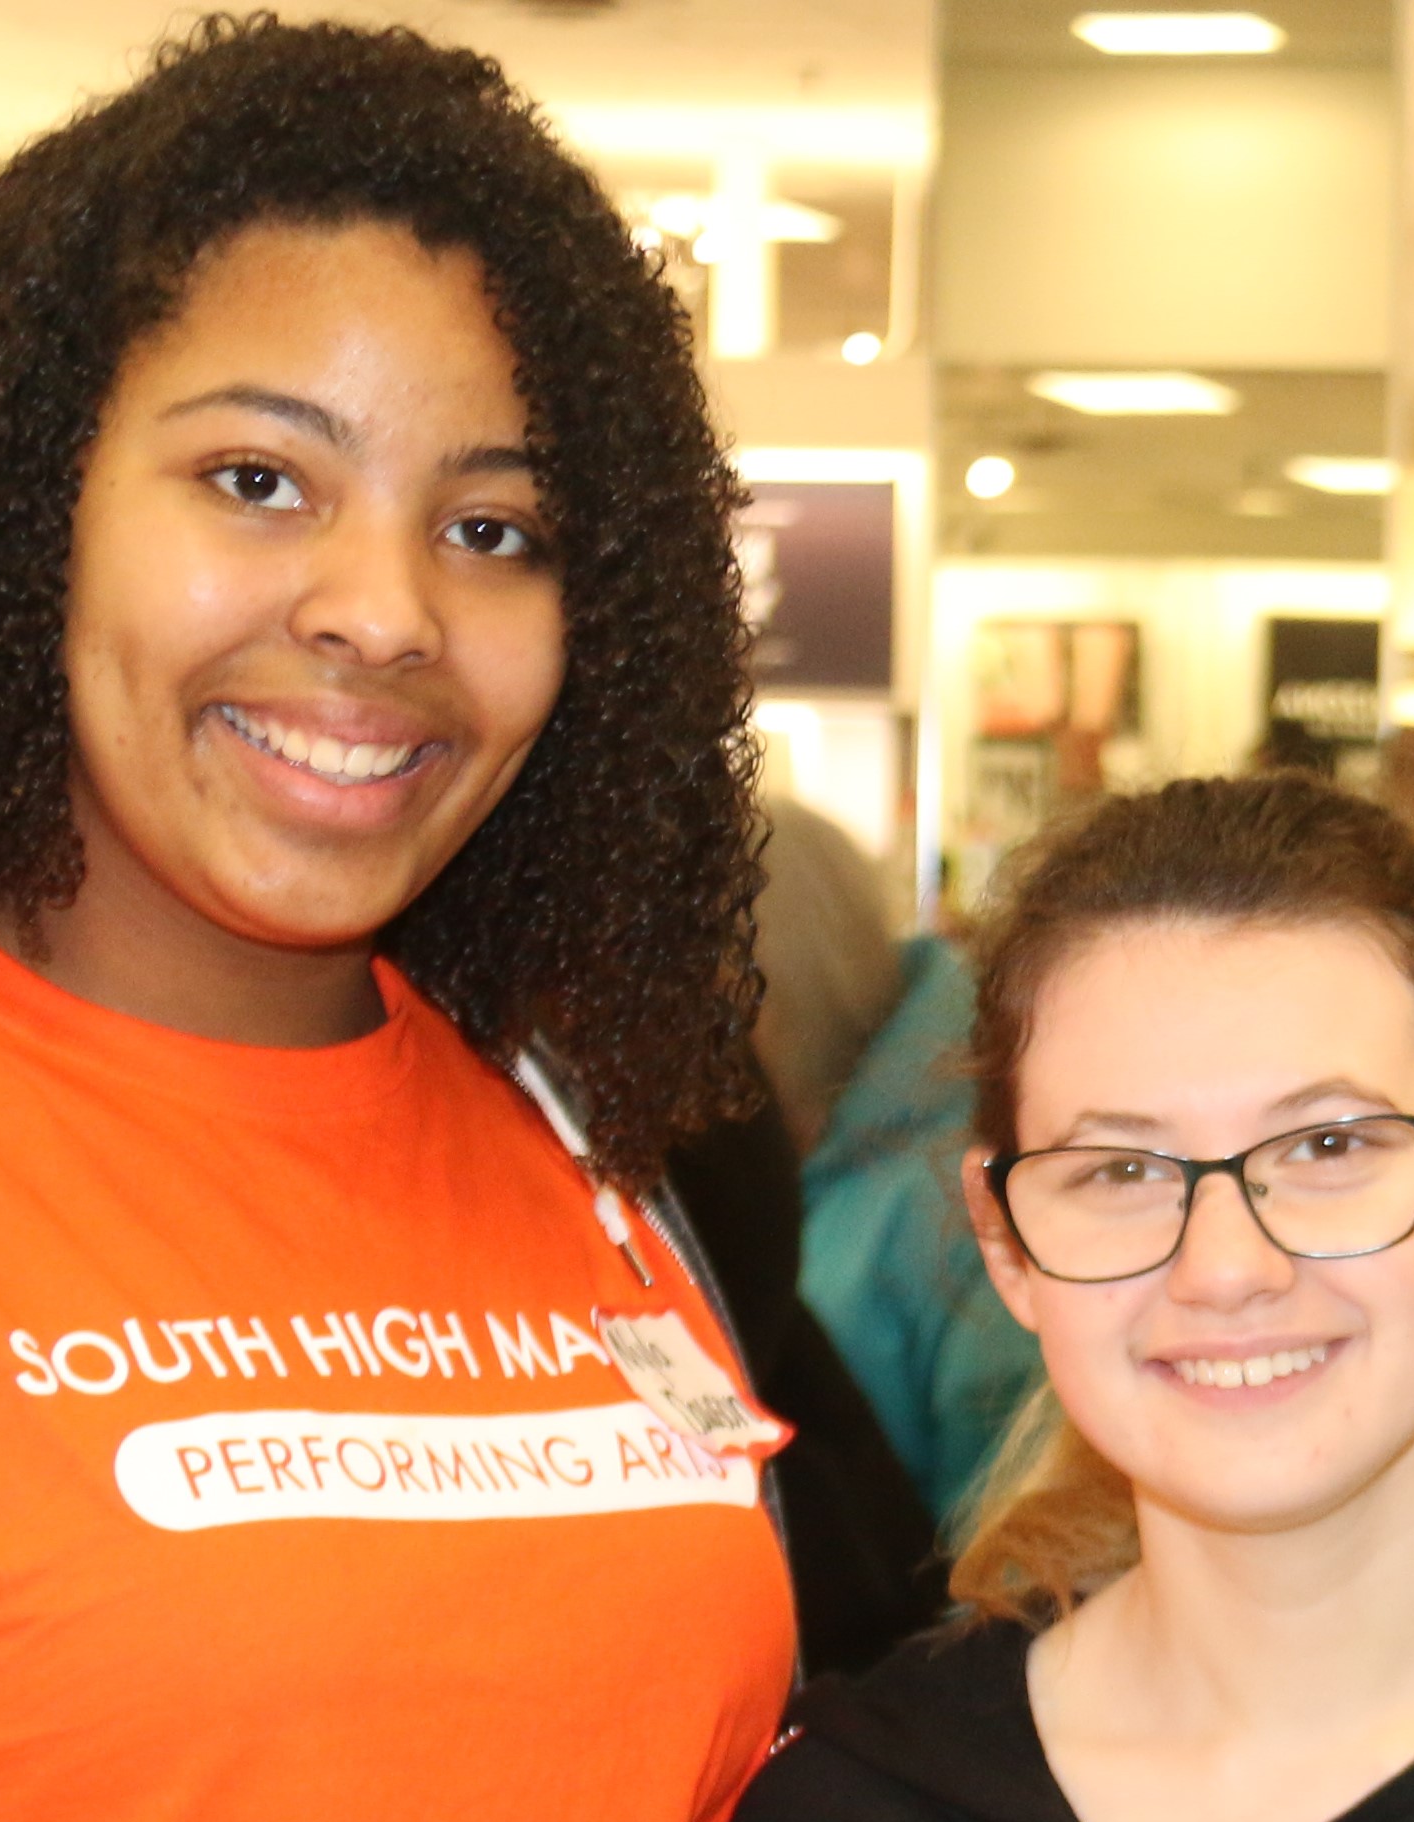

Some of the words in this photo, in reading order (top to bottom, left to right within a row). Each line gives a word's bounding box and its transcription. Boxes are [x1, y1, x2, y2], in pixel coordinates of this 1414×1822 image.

[9, 1312, 284, 1396] SOUTH
[291, 1305, 483, 1379] HIGH
[175, 1434, 594, 1502] PERFORMING
